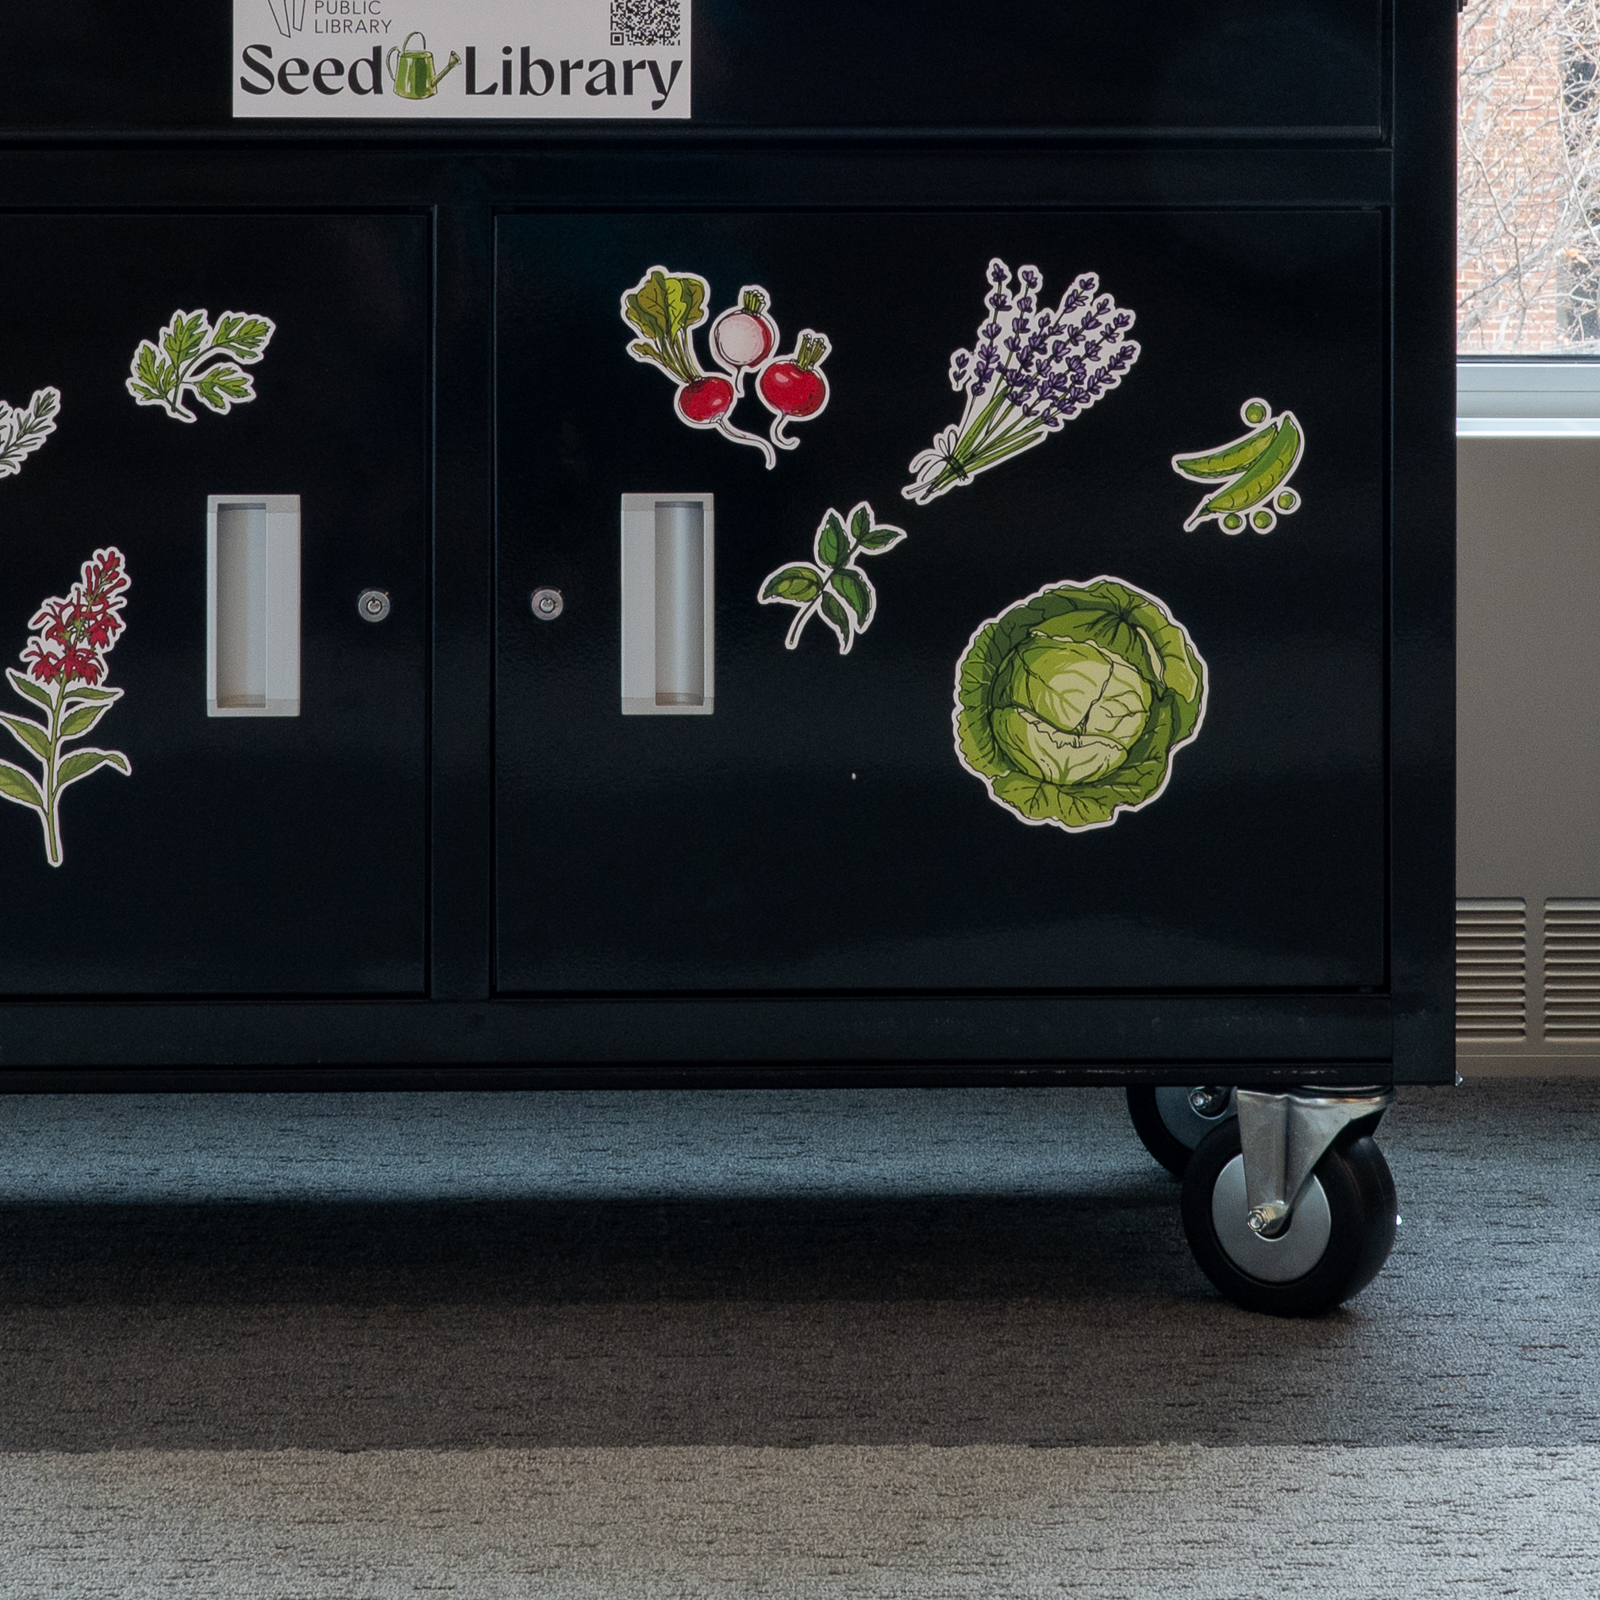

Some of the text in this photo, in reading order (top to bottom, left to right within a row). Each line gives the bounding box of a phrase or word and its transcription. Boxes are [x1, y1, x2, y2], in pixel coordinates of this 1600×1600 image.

[314, 0, 382, 15] PUBLIC
[314, 18, 392, 34] LIBRARY
[240, 44, 683, 111] Seed Library
